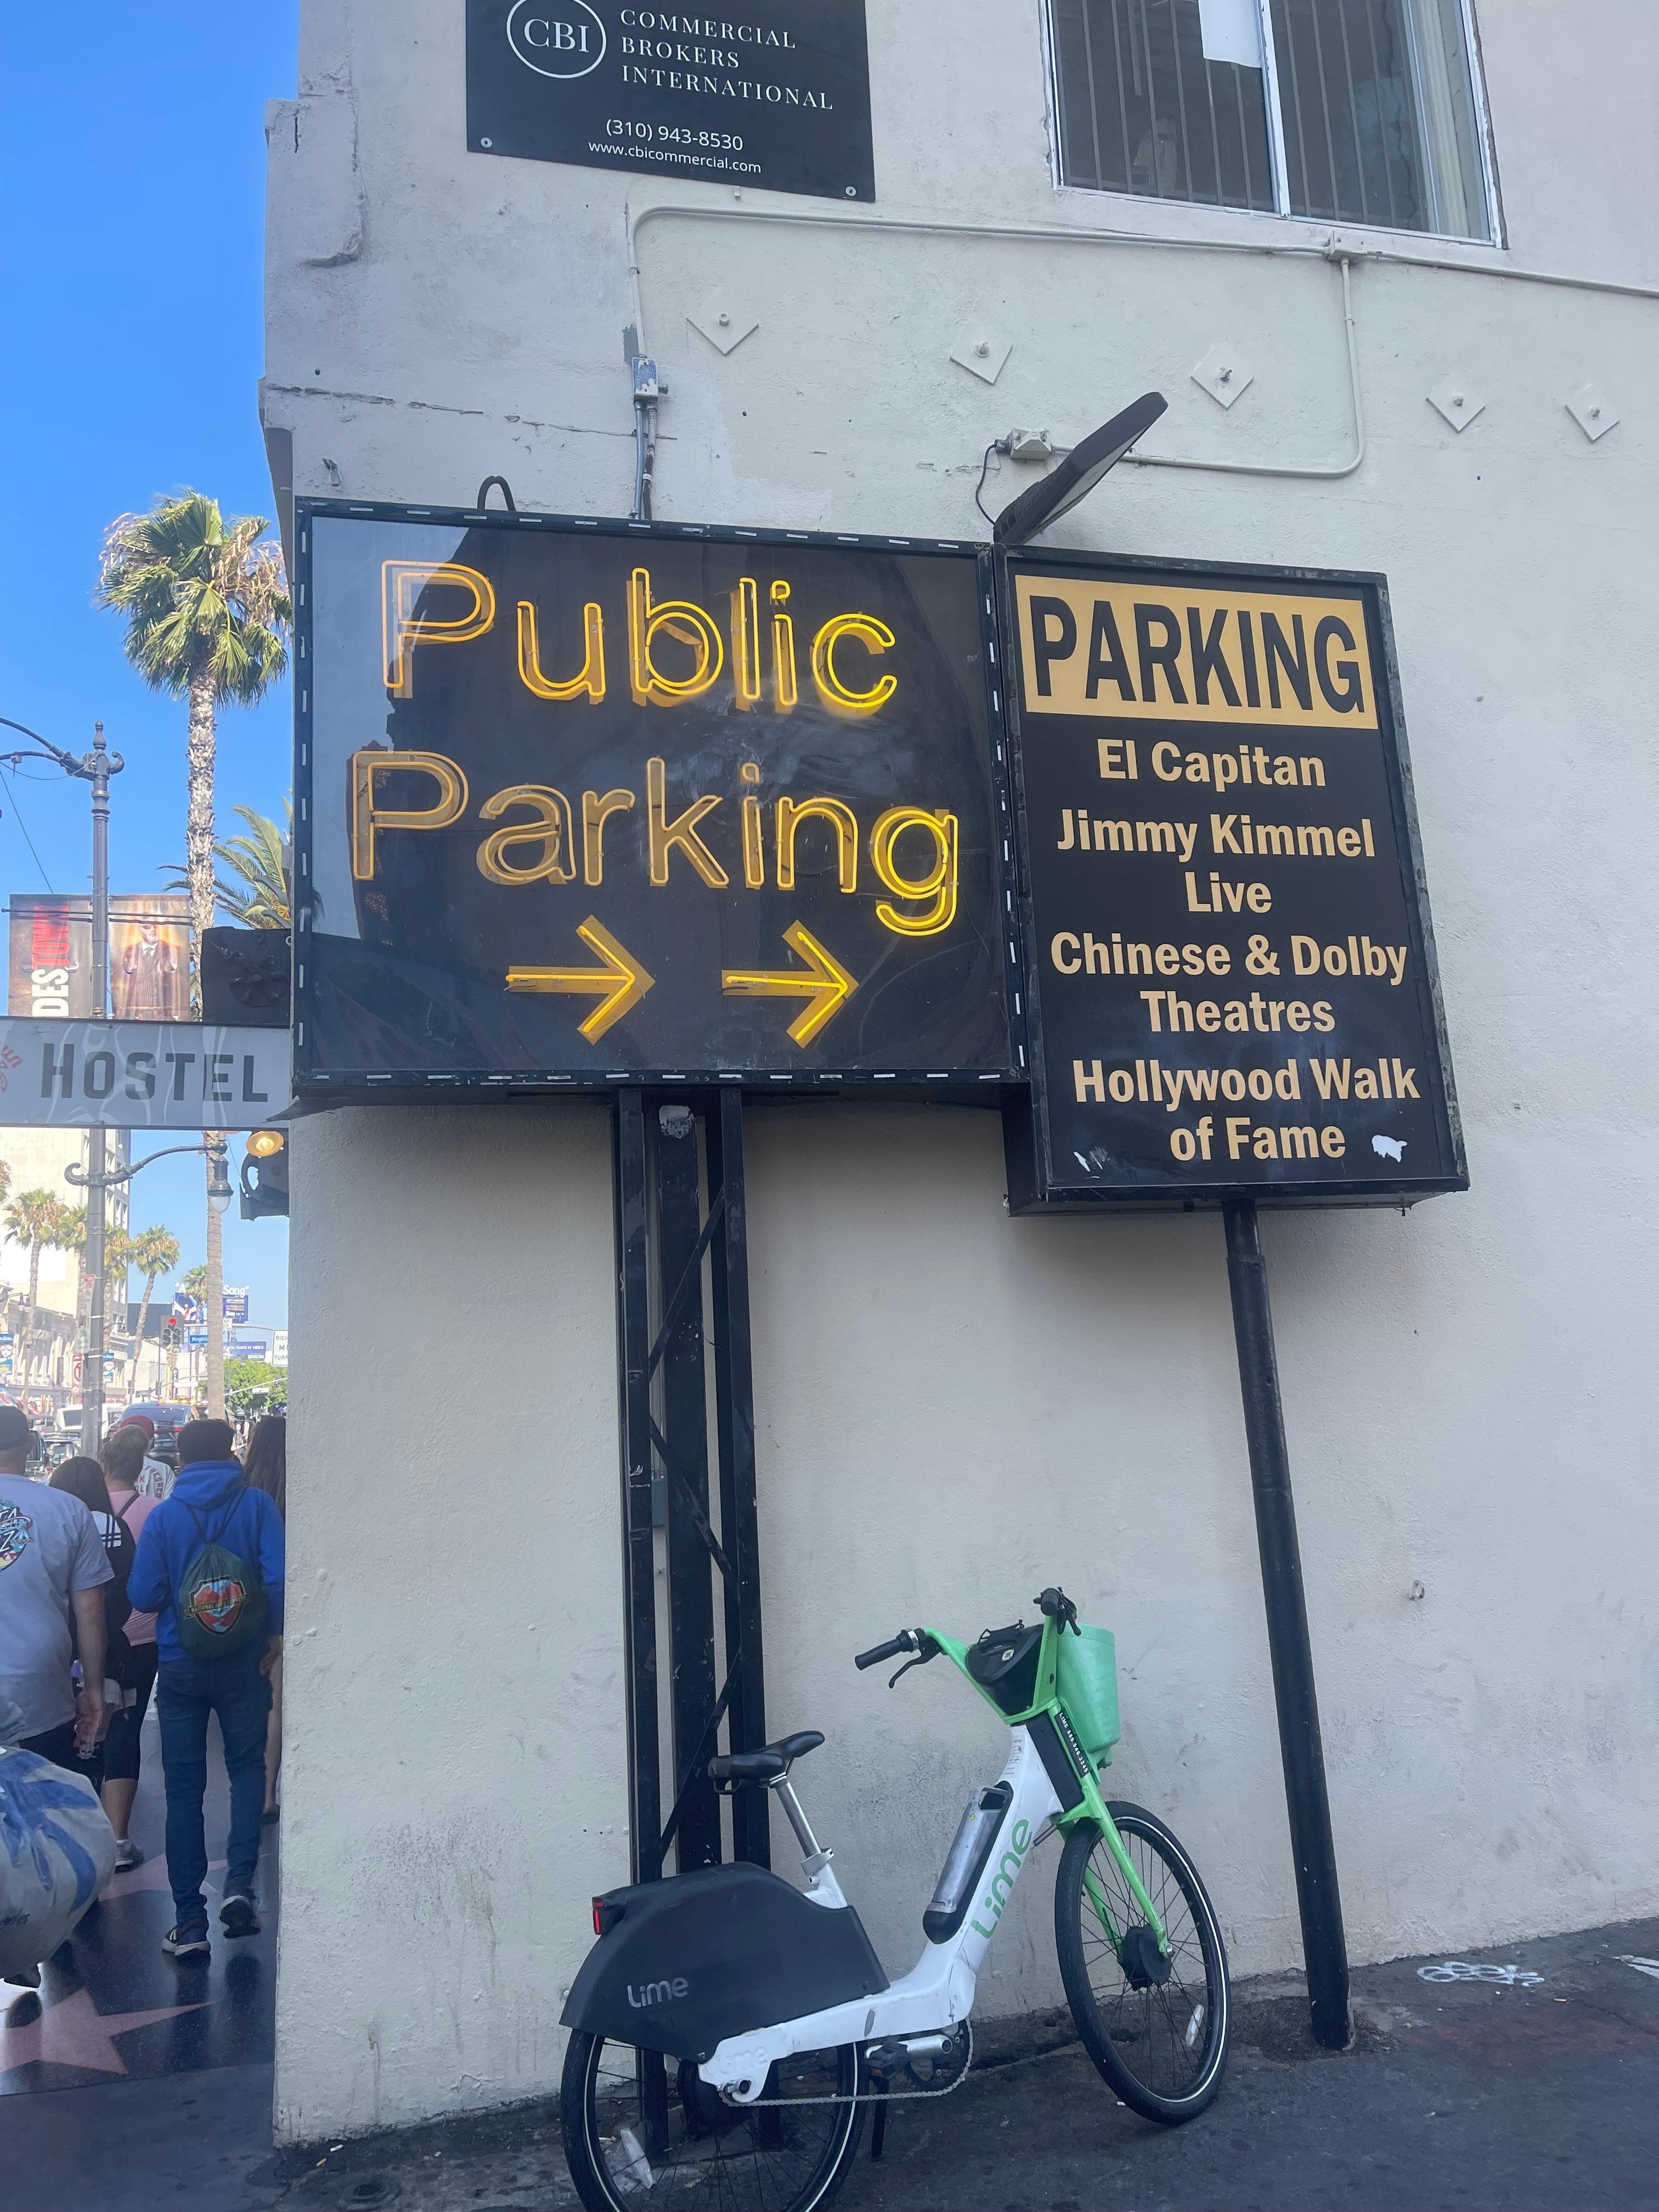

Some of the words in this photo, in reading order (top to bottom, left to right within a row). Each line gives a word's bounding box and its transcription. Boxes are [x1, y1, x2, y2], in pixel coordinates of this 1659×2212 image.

[523, 18, 590, 53] CBI
[620, 9, 797, 49] COMMERCIAL
[621, 36, 740, 69] BROKERS
[622, 65, 834, 110] INTERNATIONAL
[606, 119, 653, 142] (310)
[658, 126, 744, 151] 943-8530
[589, 142, 761, 174] www.cbicommercial.com
[381, 559, 898, 713] Public
[1029, 595, 1365, 714] PARKING
[1097, 738, 1137, 779] El
[1151, 741, 1326, 792] Capitan
[351, 750, 958, 937] Parking
[1057, 809, 1198, 862] Jimmy
[1211, 814, 1375, 858] Kimmel
[1185, 872, 1272, 913] Live
[31, 905, 70, 1017] DESTOWN
[1050, 932, 1232, 976] Chinese
[1246, 934, 1280, 976] &
[1292, 936, 1408, 986] Dolby
[1139, 991, 1336, 1033] Theatres
[40, 1042, 269, 1103] HOSTEL
[1071, 1059, 1298, 1112] Hollywood
[1310, 1058, 1421, 1101] Walk
[1170, 1116, 1214, 1161] of
[1226, 1116, 1346, 1159] Fame
[1059, 1712, 1069, 1729] LIME
[970, 1819, 1032, 1939] Lime
[627, 1977, 689, 2008] Lime
